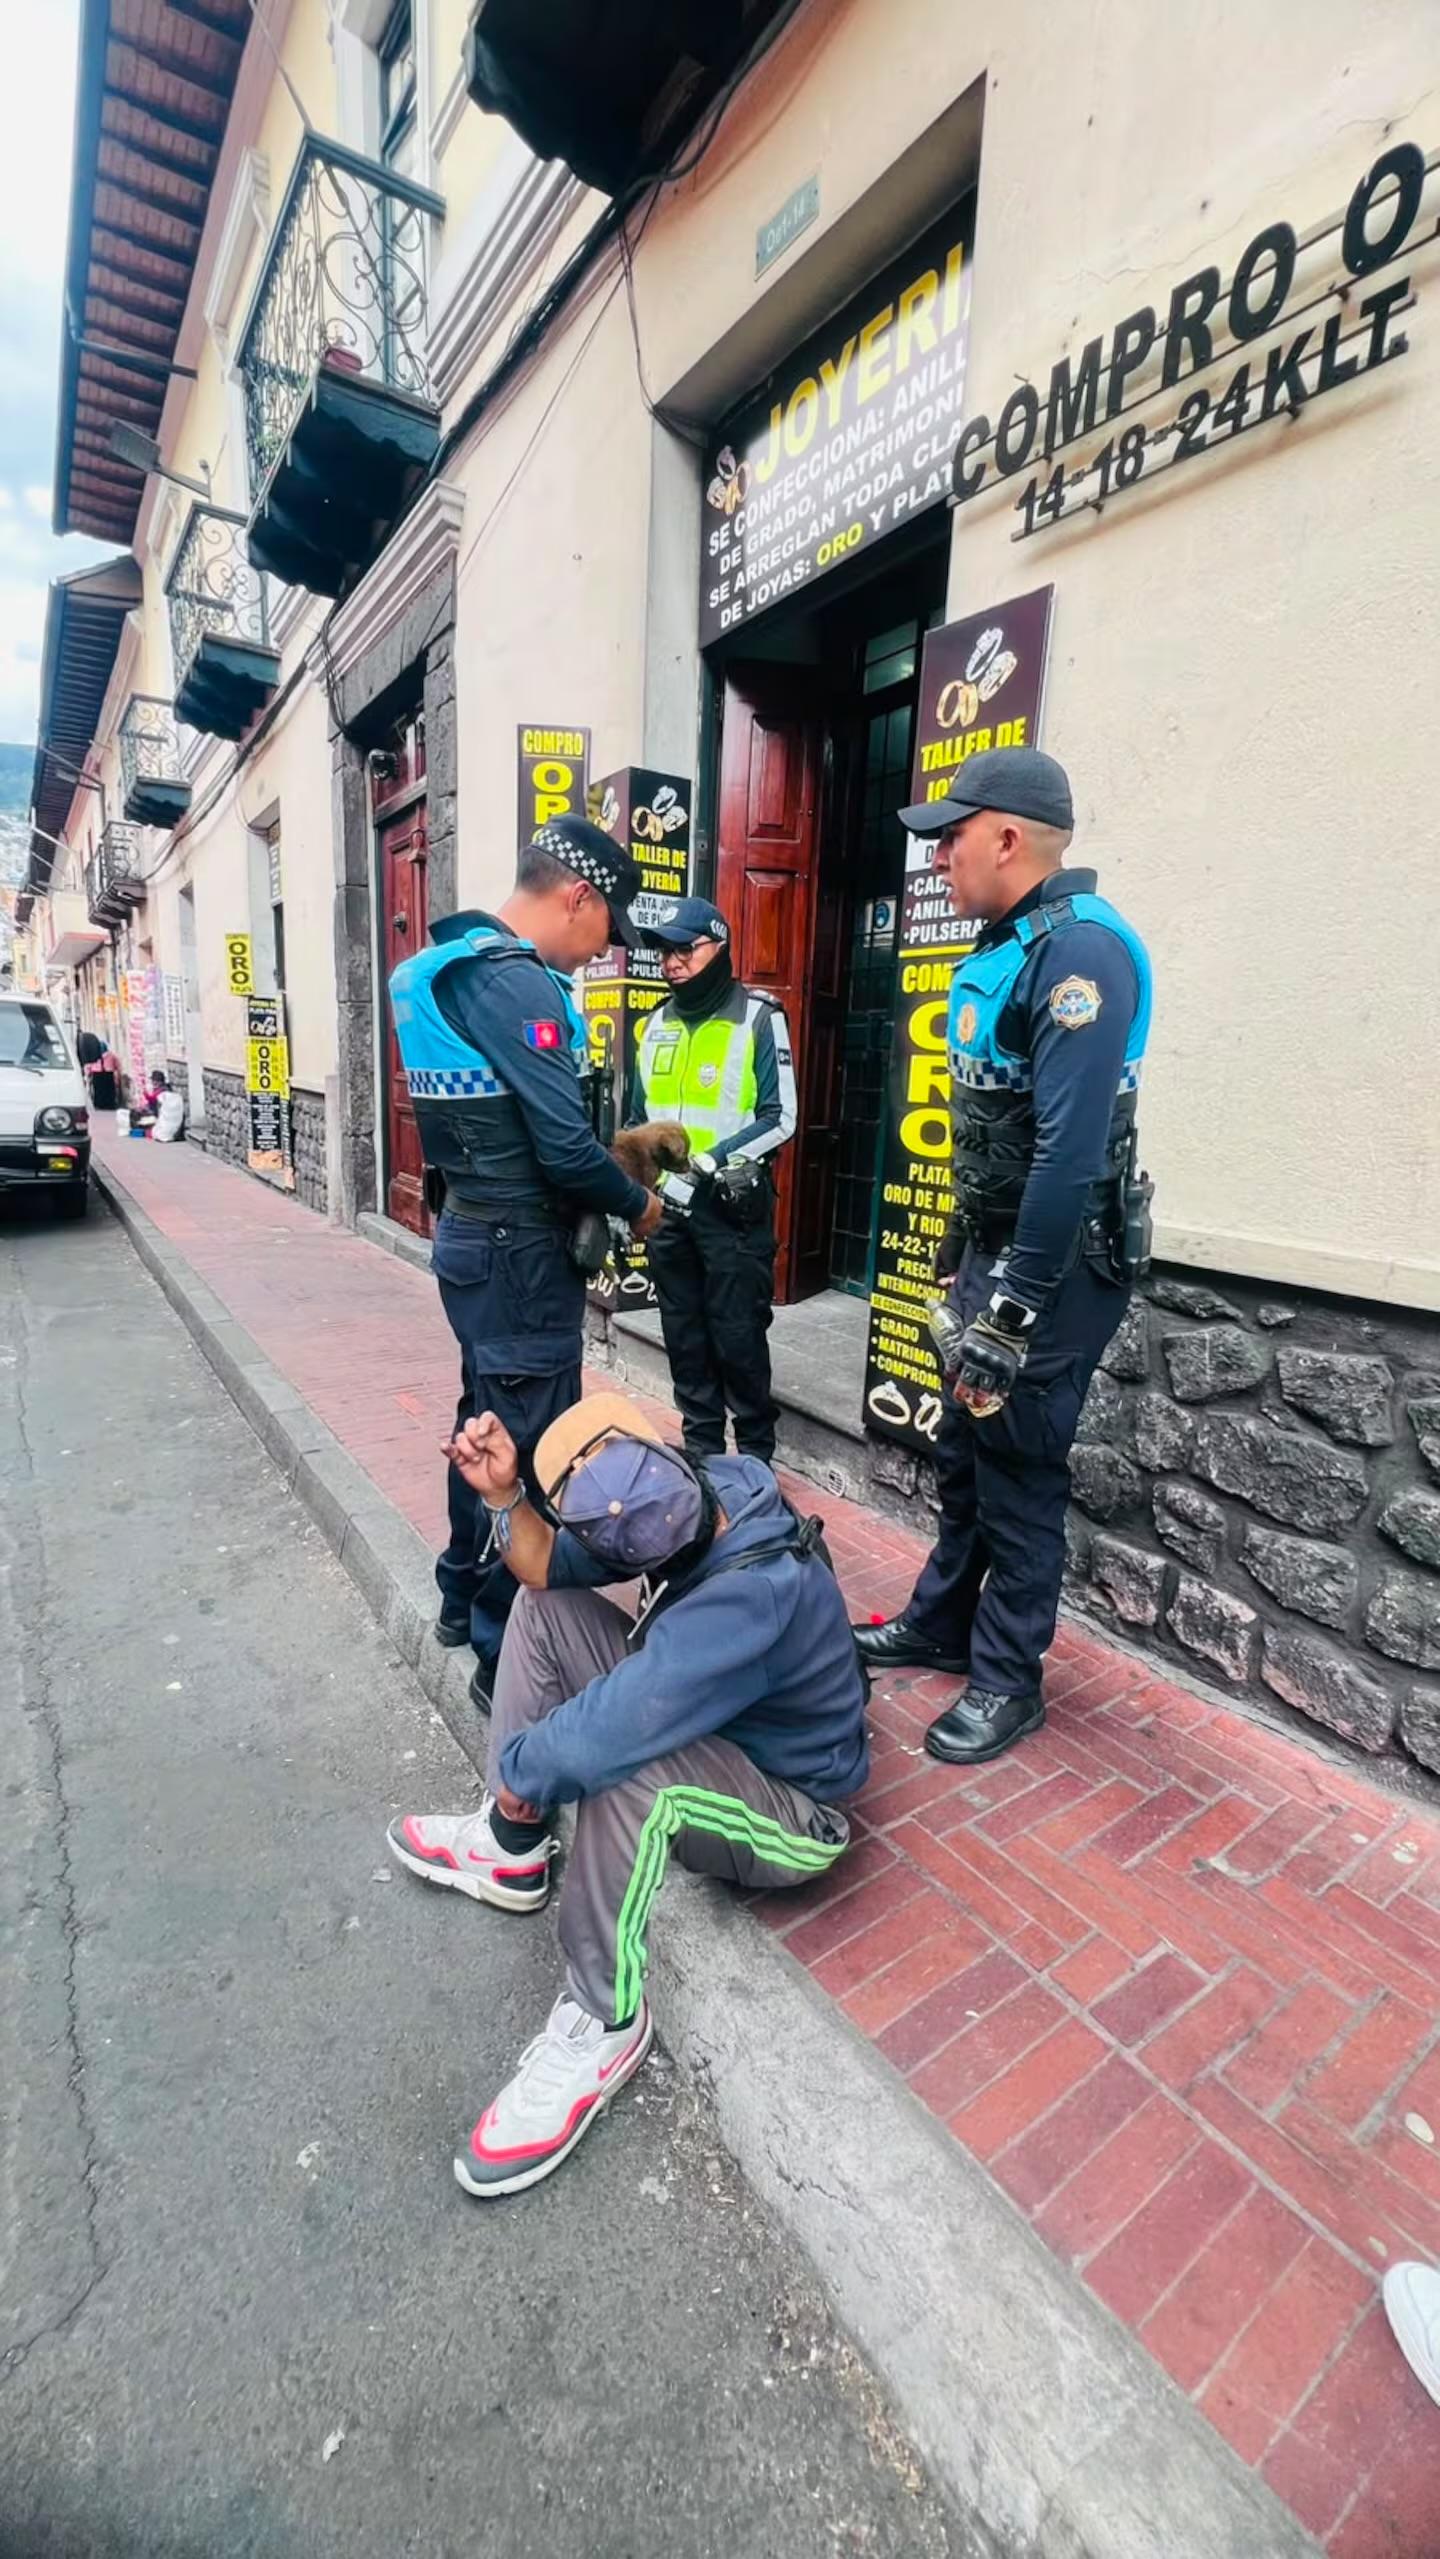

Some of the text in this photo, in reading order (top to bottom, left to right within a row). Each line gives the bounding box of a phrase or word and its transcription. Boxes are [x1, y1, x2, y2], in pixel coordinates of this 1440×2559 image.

[954, 142, 1427, 499] COMPRO O
[755, 241, 971, 483] JOYERI
[708, 339, 966, 557] SE CONFECCIONA: ANILL
[720, 381, 963, 575] DE GRADO, MATRIMONI
[709, 419, 961, 608] SE ARREGLAN TODA CLA
[720, 460, 955, 629] DE JOYAS: ORO Y PLAT
[523, 729, 584, 756] COMPRO
[921, 716, 1026, 773] TALLER DE
[532, 760, 573, 844] OR
[631, 841, 687, 869] TALLER DE
[912, 901, 956, 922] ANILL
[909, 919, 989, 945] PULSERA
[229, 941, 249, 985] ORO
[902, 963, 954, 994] COM
[258, 1046, 271, 1089] ORO
[908, 1162, 952, 1187] PLATA
[883, 1183, 956, 1214] ORO DE MI
[908, 1212, 945, 1238] Y RIO
[896, 1257, 935, 1281] PRECI
[879, 1316, 920, 1343] GRADO
[878, 1335, 938, 1370] MATRIMO
[876, 1354, 943, 1392] COMPROM
